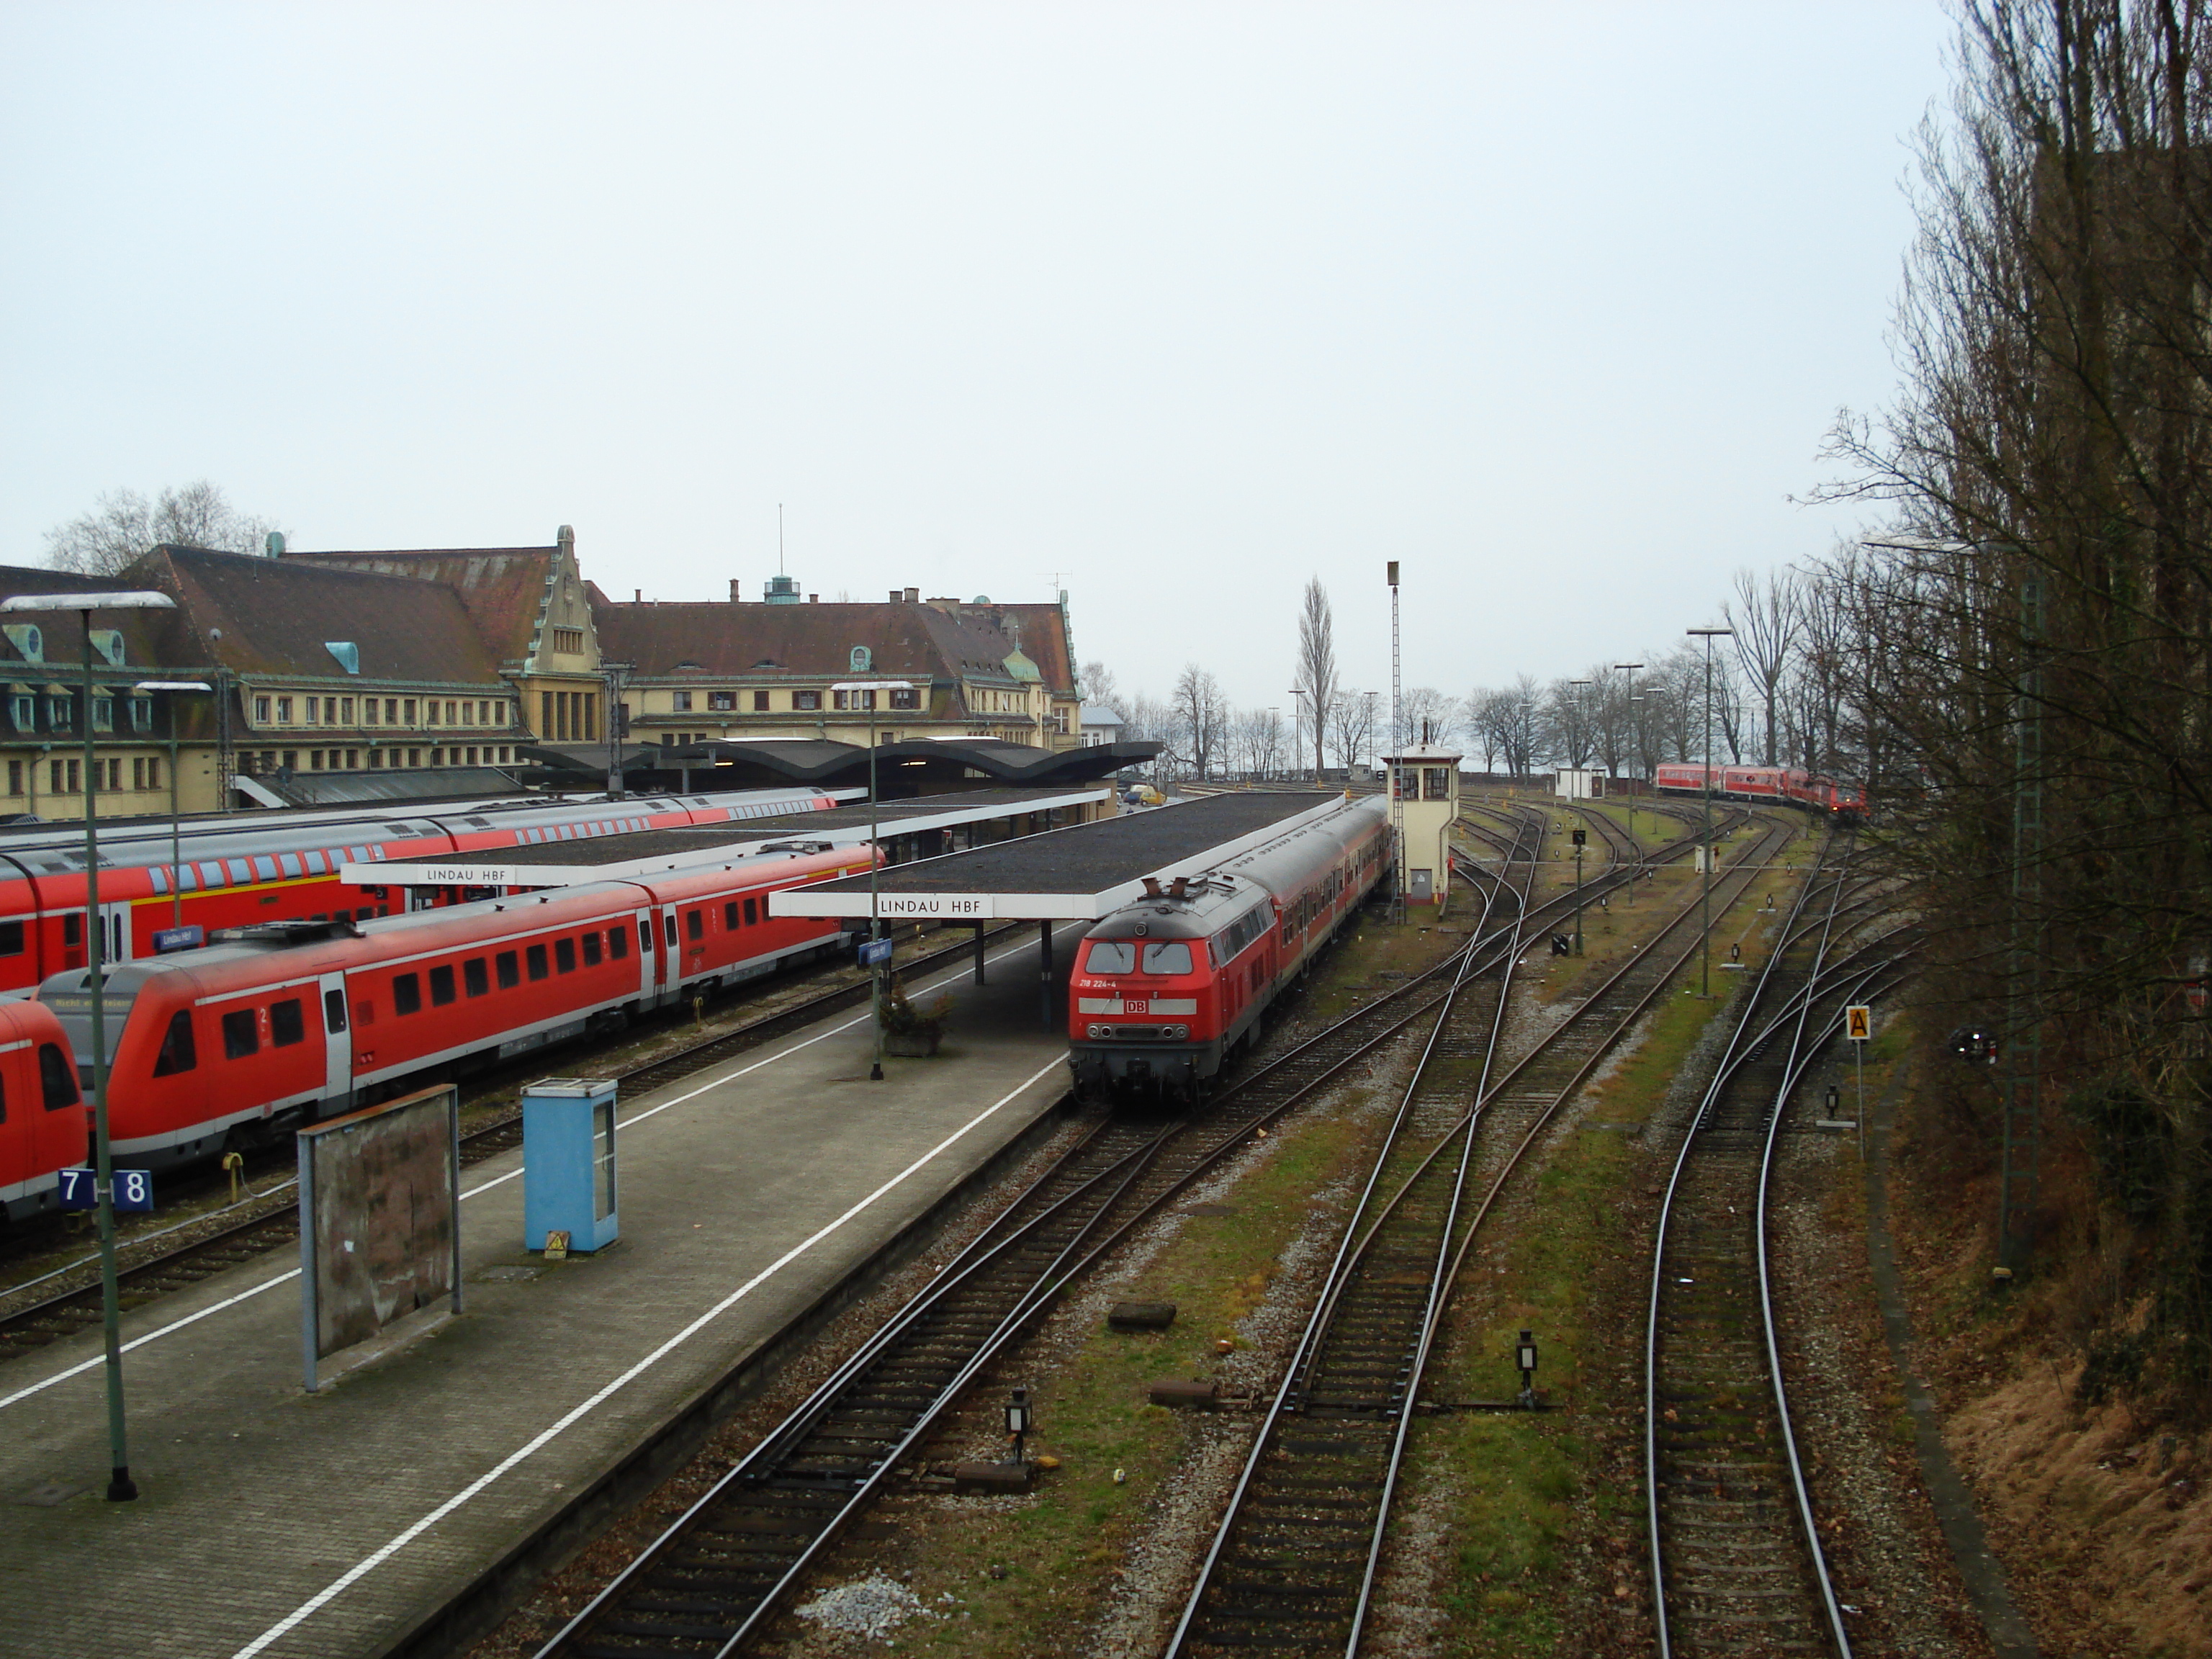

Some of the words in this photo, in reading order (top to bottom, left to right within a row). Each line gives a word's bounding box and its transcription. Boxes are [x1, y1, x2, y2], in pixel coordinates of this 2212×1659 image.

[428, 870, 473, 880] LINDAU
[482, 871, 505, 880] HBF
[881, 900, 939, 912] LINDAU
[952, 901, 980, 912] HBF
[163, 934, 181, 945] Lindau
[603, 931, 607, 943] 2
[1128, 1002, 1144, 1012] DB
[260, 1008, 266, 1022] 2
[1851, 1010, 1867, 1035] A
[62, 1172, 79, 1200] 7
[127, 1172, 145, 1202] 8
